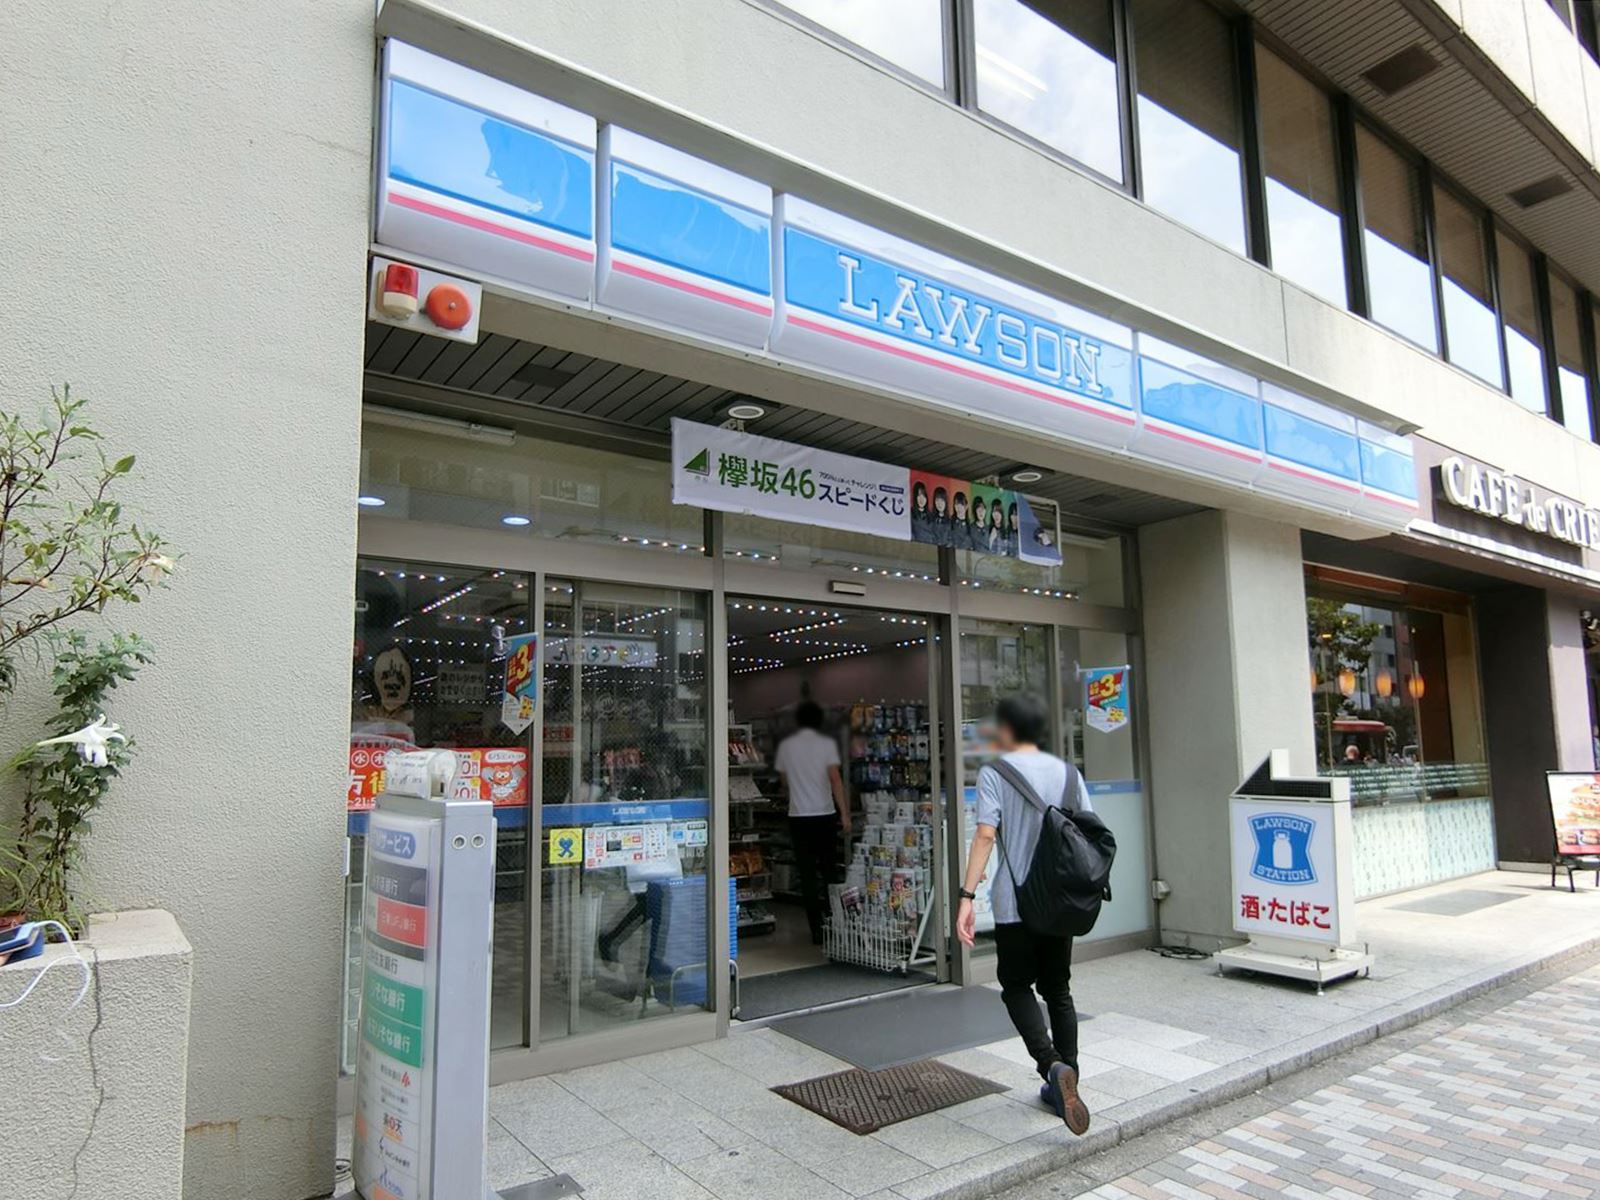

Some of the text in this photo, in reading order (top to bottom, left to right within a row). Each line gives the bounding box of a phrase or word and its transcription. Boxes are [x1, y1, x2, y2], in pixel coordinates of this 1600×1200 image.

[839, 253, 1103, 395] LAWSON
[718, 453, 816, 499] 欅坂46
[818, 483, 905, 516] スピードくじ
[1522, 488, 1547, 532] de
[1254, 817, 1310, 834] LAWSON
[1256, 864, 1310, 882] STATION
